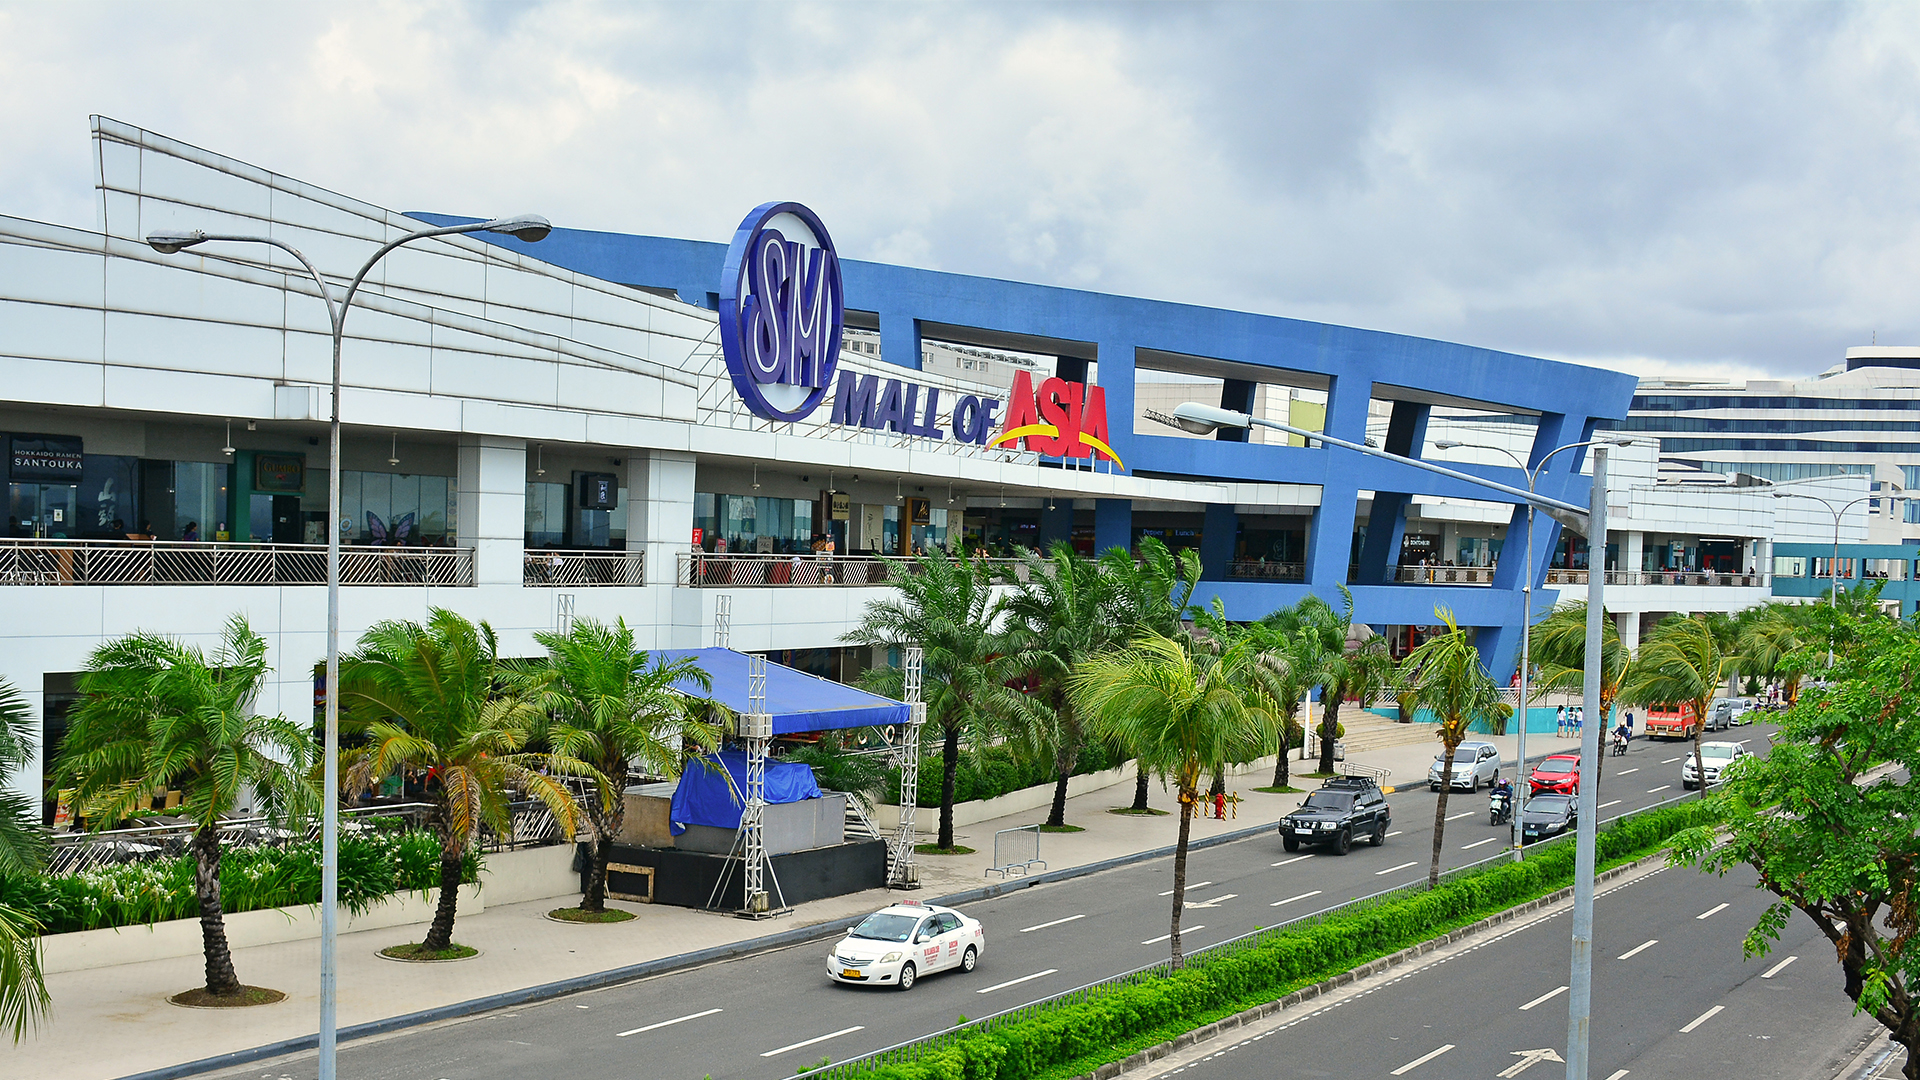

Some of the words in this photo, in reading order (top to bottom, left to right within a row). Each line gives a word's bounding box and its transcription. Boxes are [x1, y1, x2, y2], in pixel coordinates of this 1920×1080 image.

[742, 229, 834, 389] SM
[830, 370, 944, 440] MALL
[952, 395, 999, 446] OF
[998, 369, 1111, 461] ASIA
[14, 449, 54, 457] HOKKAIDO
[14, 458, 82, 469] SANTOUKA
[1143, 528, 1164, 536] Pepper
[1175, 529, 1195, 537] Lunch
